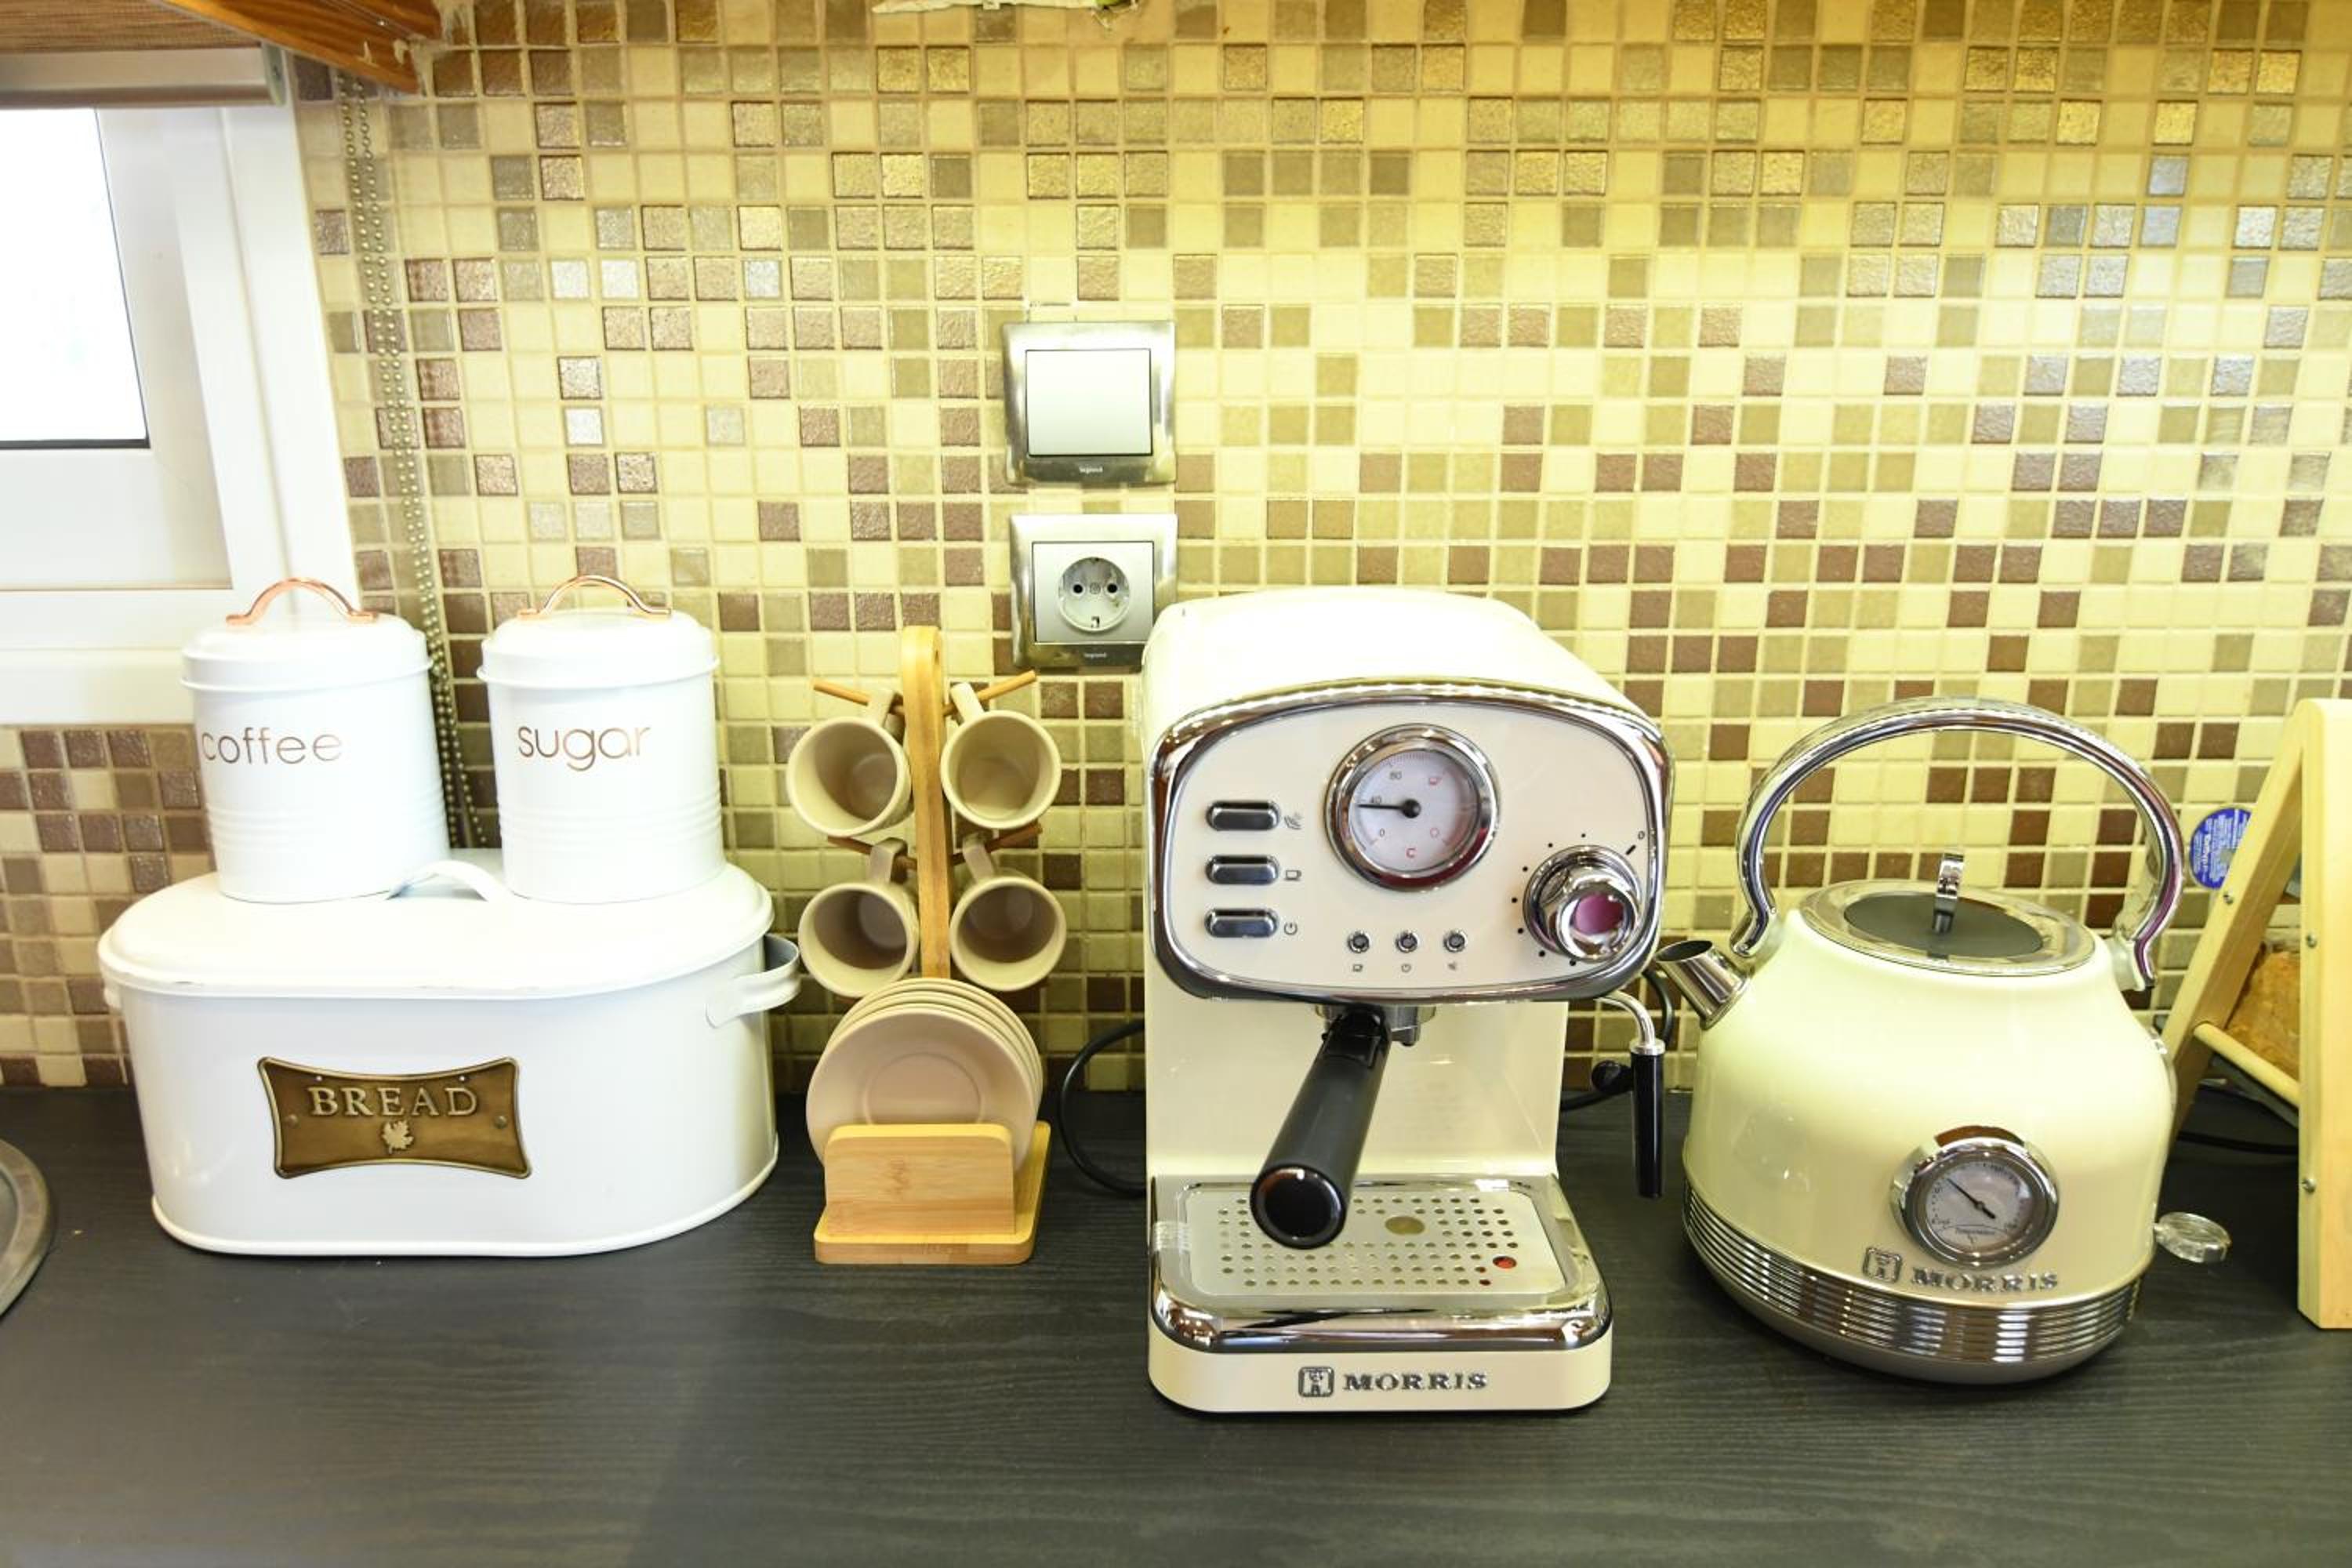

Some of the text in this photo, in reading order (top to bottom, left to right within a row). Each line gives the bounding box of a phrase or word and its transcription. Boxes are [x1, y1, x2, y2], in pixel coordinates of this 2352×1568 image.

[200, 726, 343, 765] coffee
[517, 724, 652, 772] sugar
[307, 1086, 478, 1118] BREAD
[1911, 1266, 2059, 1293] MORRIS
[1343, 1371, 1487, 1391] MORRIS
